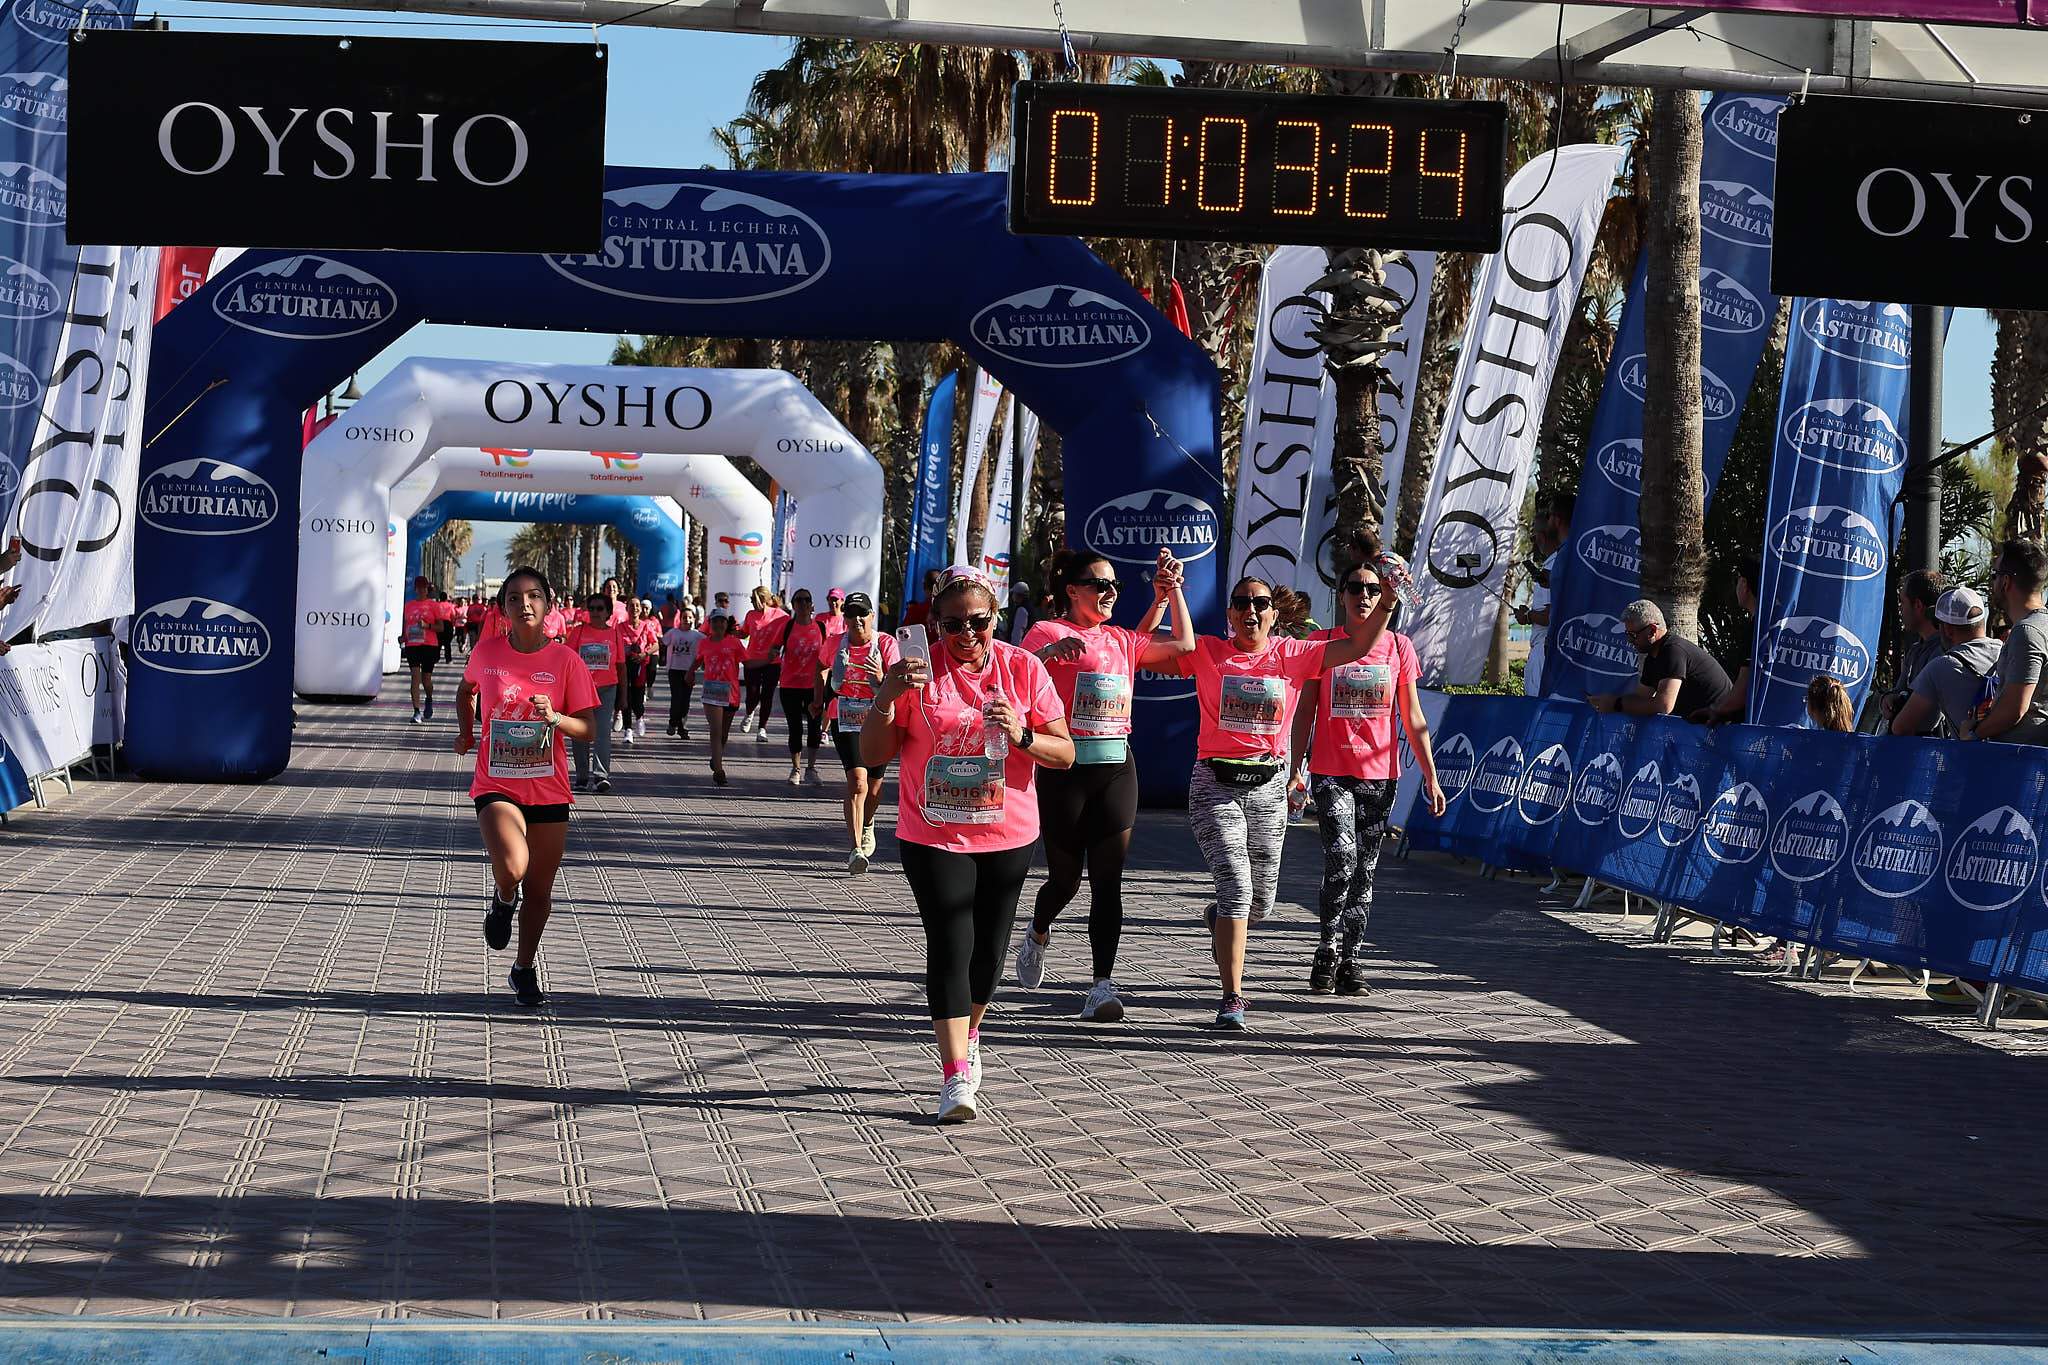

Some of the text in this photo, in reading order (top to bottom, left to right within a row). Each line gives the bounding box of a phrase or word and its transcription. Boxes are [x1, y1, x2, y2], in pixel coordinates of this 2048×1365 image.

[0, 93, 67, 121] STURIA
[157, 101, 529, 187] OYSHO
[0, 190, 66, 218] URIANA
[1856, 168, 2048, 244] OYS
[607, 215, 800, 236] CENTRAL LECHERA
[223, 284, 382, 320] ASTURIANA
[255, 281, 380, 297] CENTRAL LECHERA
[1009, 312, 1131, 323] CENTRAL LECHERA
[1700, 296, 1753, 328] RIANA
[1832, 309, 1880, 325] CENTRAL
[985, 317, 1140, 347] ASTURIANA
[17, 261, 116, 562] OYSH
[484, 379, 713, 430] OYSHO
[1427, 212, 1574, 590] OYSHO
[345, 427, 414, 443] OYSHO
[1794, 415, 1895, 466] ASTURIANA
[1812, 416, 1895, 444] CENTRAL LECHERA
[777, 438, 843, 453] OYSHO
[479, 470, 533, 480] TotalEnergies
[590, 474, 644, 483] TotalEnergies
[144, 485, 269, 518] ASTURIANA
[162, 483, 266, 496] CENTRAL LECHERA
[311, 518, 375, 535] OYSHO
[1093, 517, 1214, 545] ASTURIANA
[1114, 514, 1211, 523] CENTRAL LECHERA
[809, 534, 871, 550] OYSHO
[153, 622, 257, 635] CENTRAL LECHERA
[306, 611, 371, 628] OYSHO
[137, 623, 261, 657] ASTURIANA
[1561, 625, 1643, 670] ASTURIAN
[1780, 636, 1818, 649] ENTRAL
[1472, 762, 1518, 796] ASTURIANA
[1520, 769, 1565, 807] ASTURIANA
[1774, 820, 1839, 861] ASTURIANA
[1856, 832, 1933, 876] ASTURIANA
[1950, 842, 2029, 887] ASTURIANA
